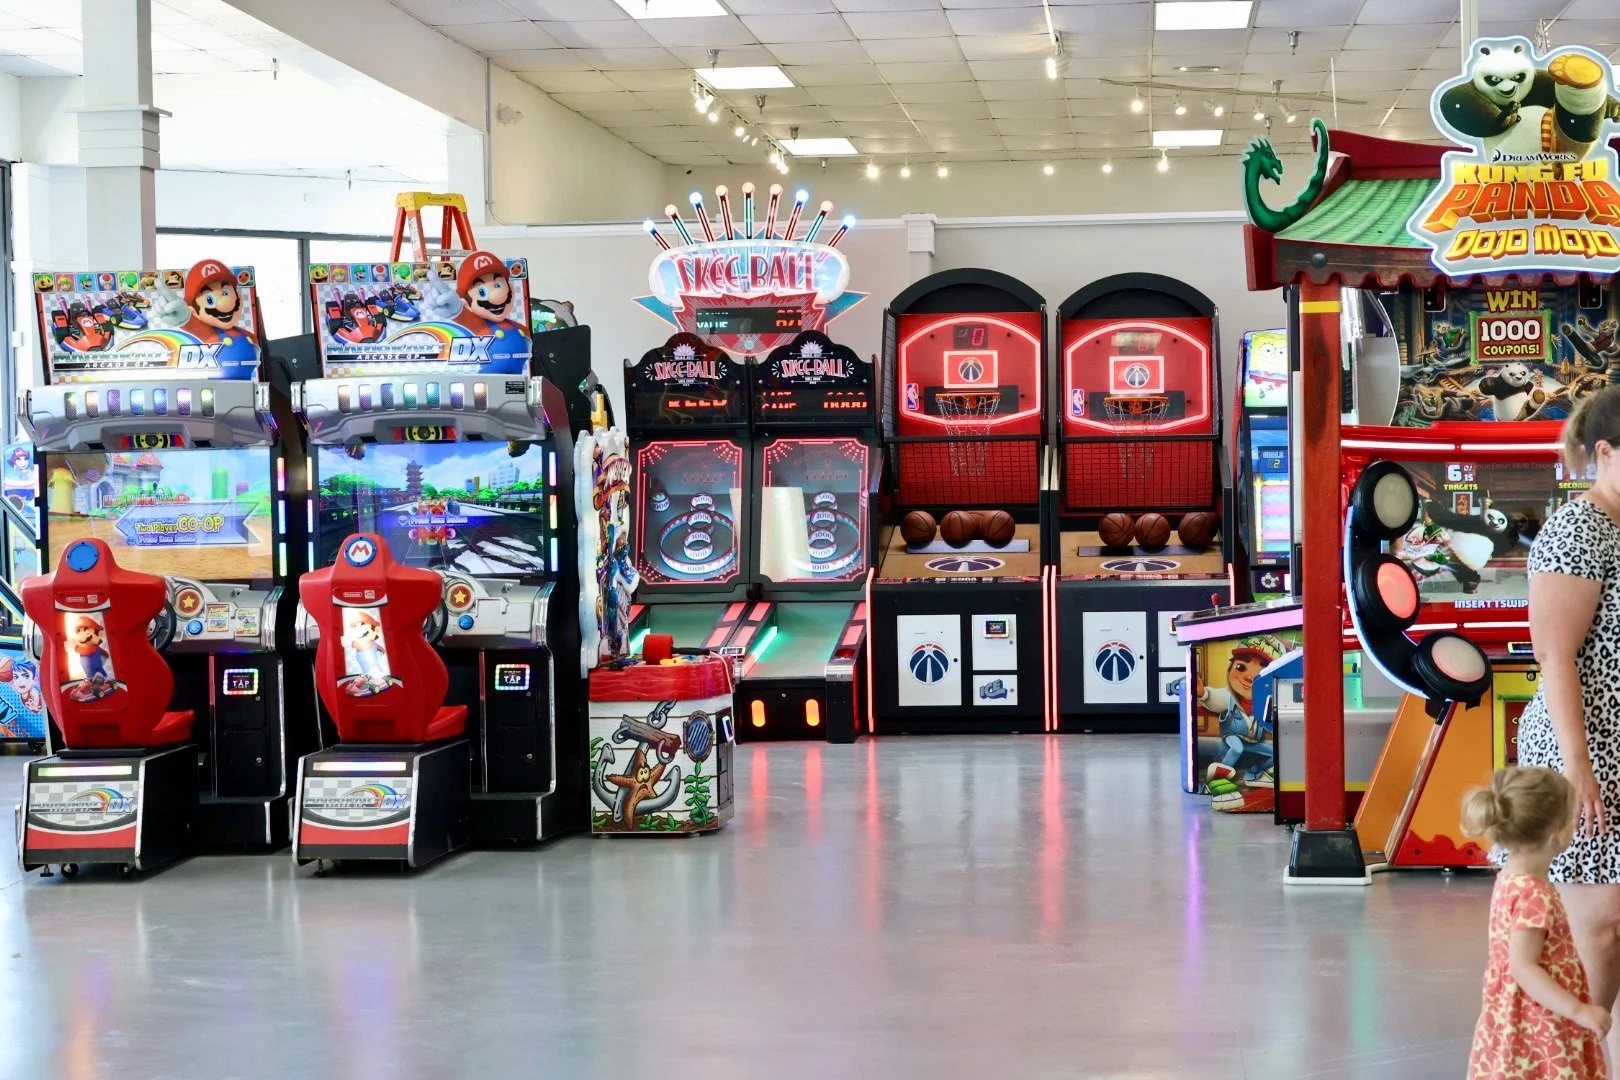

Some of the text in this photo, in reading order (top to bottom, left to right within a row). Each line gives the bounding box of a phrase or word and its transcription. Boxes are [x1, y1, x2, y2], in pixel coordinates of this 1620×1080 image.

[1455, 158, 1609, 183] KUNG FU
[1421, 180, 1620, 233] PANDA
[1445, 223, 1620, 261] DOJO MOJO
[675, 252, 816, 293] SKEE-BALL
[1486, 289, 1538, 312] WIN
[1481, 319, 1541, 342] 1000
[178, 344, 221, 369] DX
[451, 336, 494, 363] DX
[1483, 344, 1540, 356] COUPONS!
[654, 360, 719, 380] SKEE-BALL
[781, 359, 847, 378] SKEE-BALL
[1447, 464, 1462, 482] 6
[1444, 483, 1479, 491] TARGETS
[136, 514, 225, 534] Two Player CO-OP
[1454, 599, 1491, 609] INSERT
[1500, 599, 1529, 608] SWIP
[232, 680, 250, 688] TAP
[504, 675, 521, 684] TAP
[980, 679, 1008, 699] ICE
